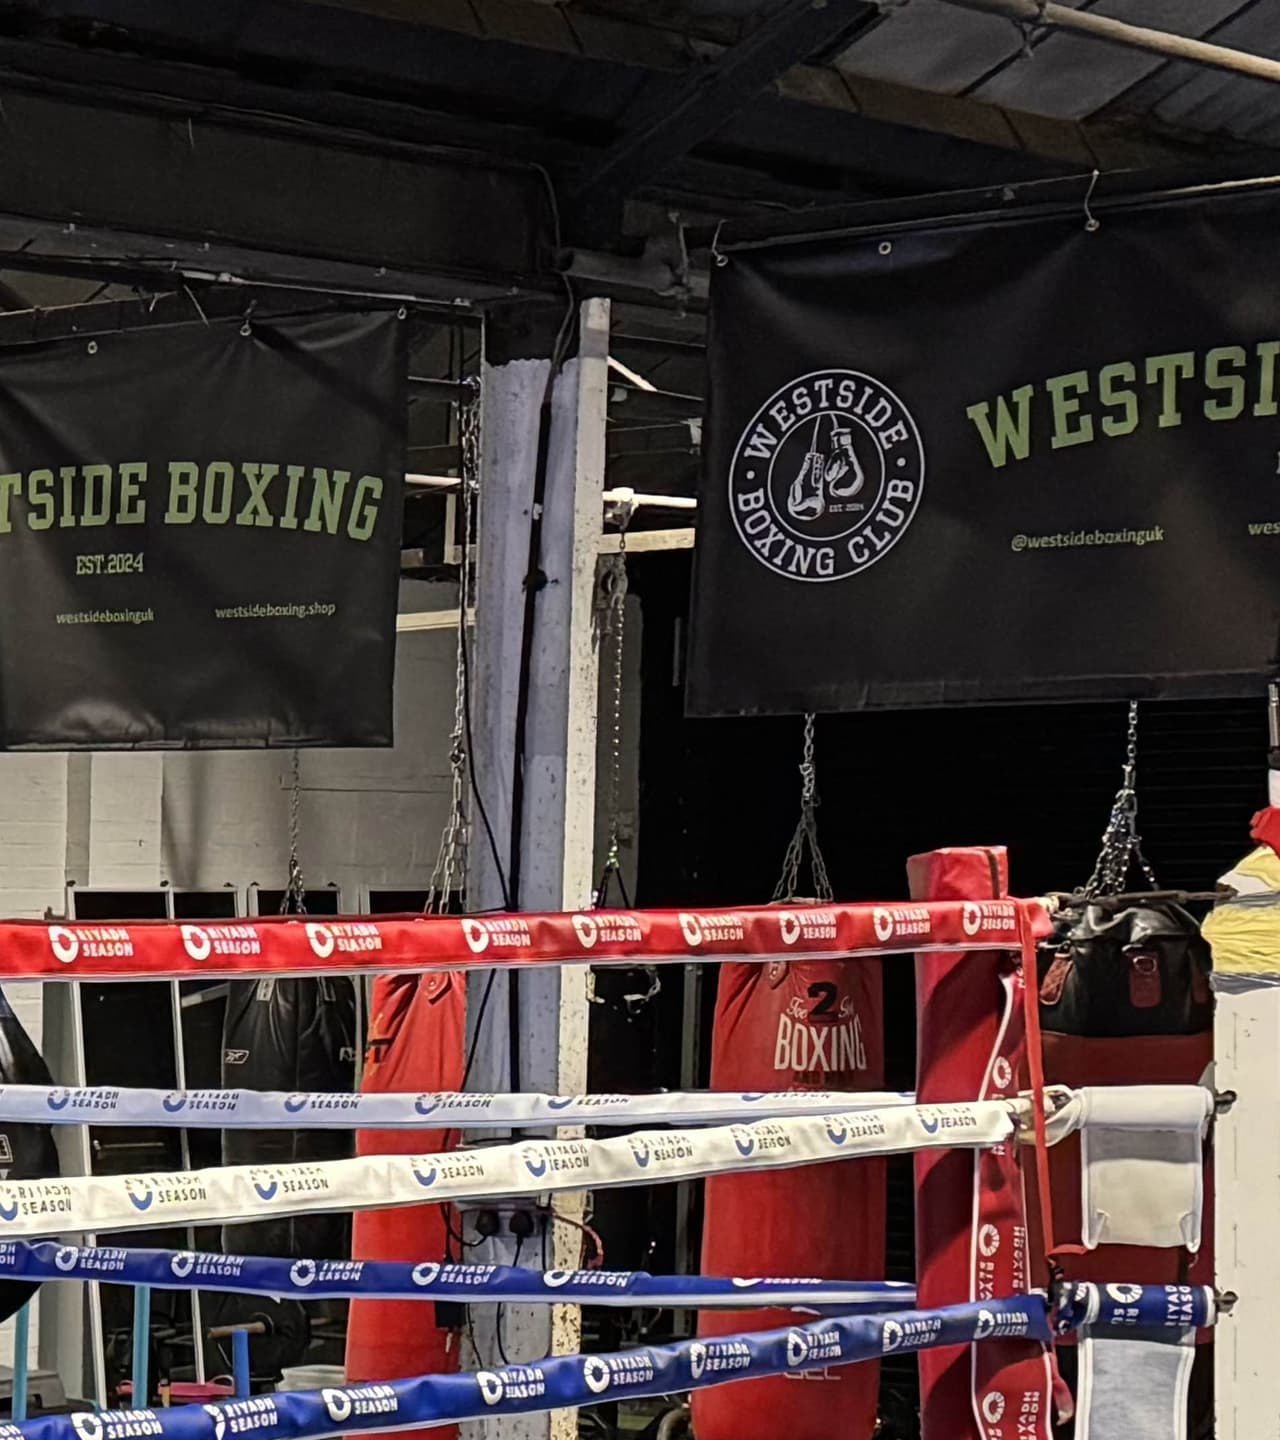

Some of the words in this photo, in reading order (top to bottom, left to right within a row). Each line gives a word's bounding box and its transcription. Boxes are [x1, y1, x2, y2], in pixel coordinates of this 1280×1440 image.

[743, 378, 909, 474] WESTSIDE
[164, 461, 384, 542] BOXING
[737, 494, 835, 576] BOXING
[847, 477, 914, 564] CLUB
[1011, 526, 1164, 552] @westsideboxinguk
[76, 552, 145, 576] EST.2024
[56, 608, 155, 627] westsideboxinguk
[215, 602, 336, 620] westsideboxing.shop
[76, 928, 130, 944] RIYADH
[802, 926, 837, 940] SEASON
[83, 943, 134, 957] SEASON
[774, 1013, 867, 1071] BOXING
[610, 1356, 651, 1372] RIYADH
[614, 1368, 653, 1385] SEASON
[227, 1397, 275, 1416] RIYADH
[103, 1408, 158, 1425] RIYADH
[231, 1410, 278, 1431] SEASON
[108, 1421, 162, 1439] SEASON
